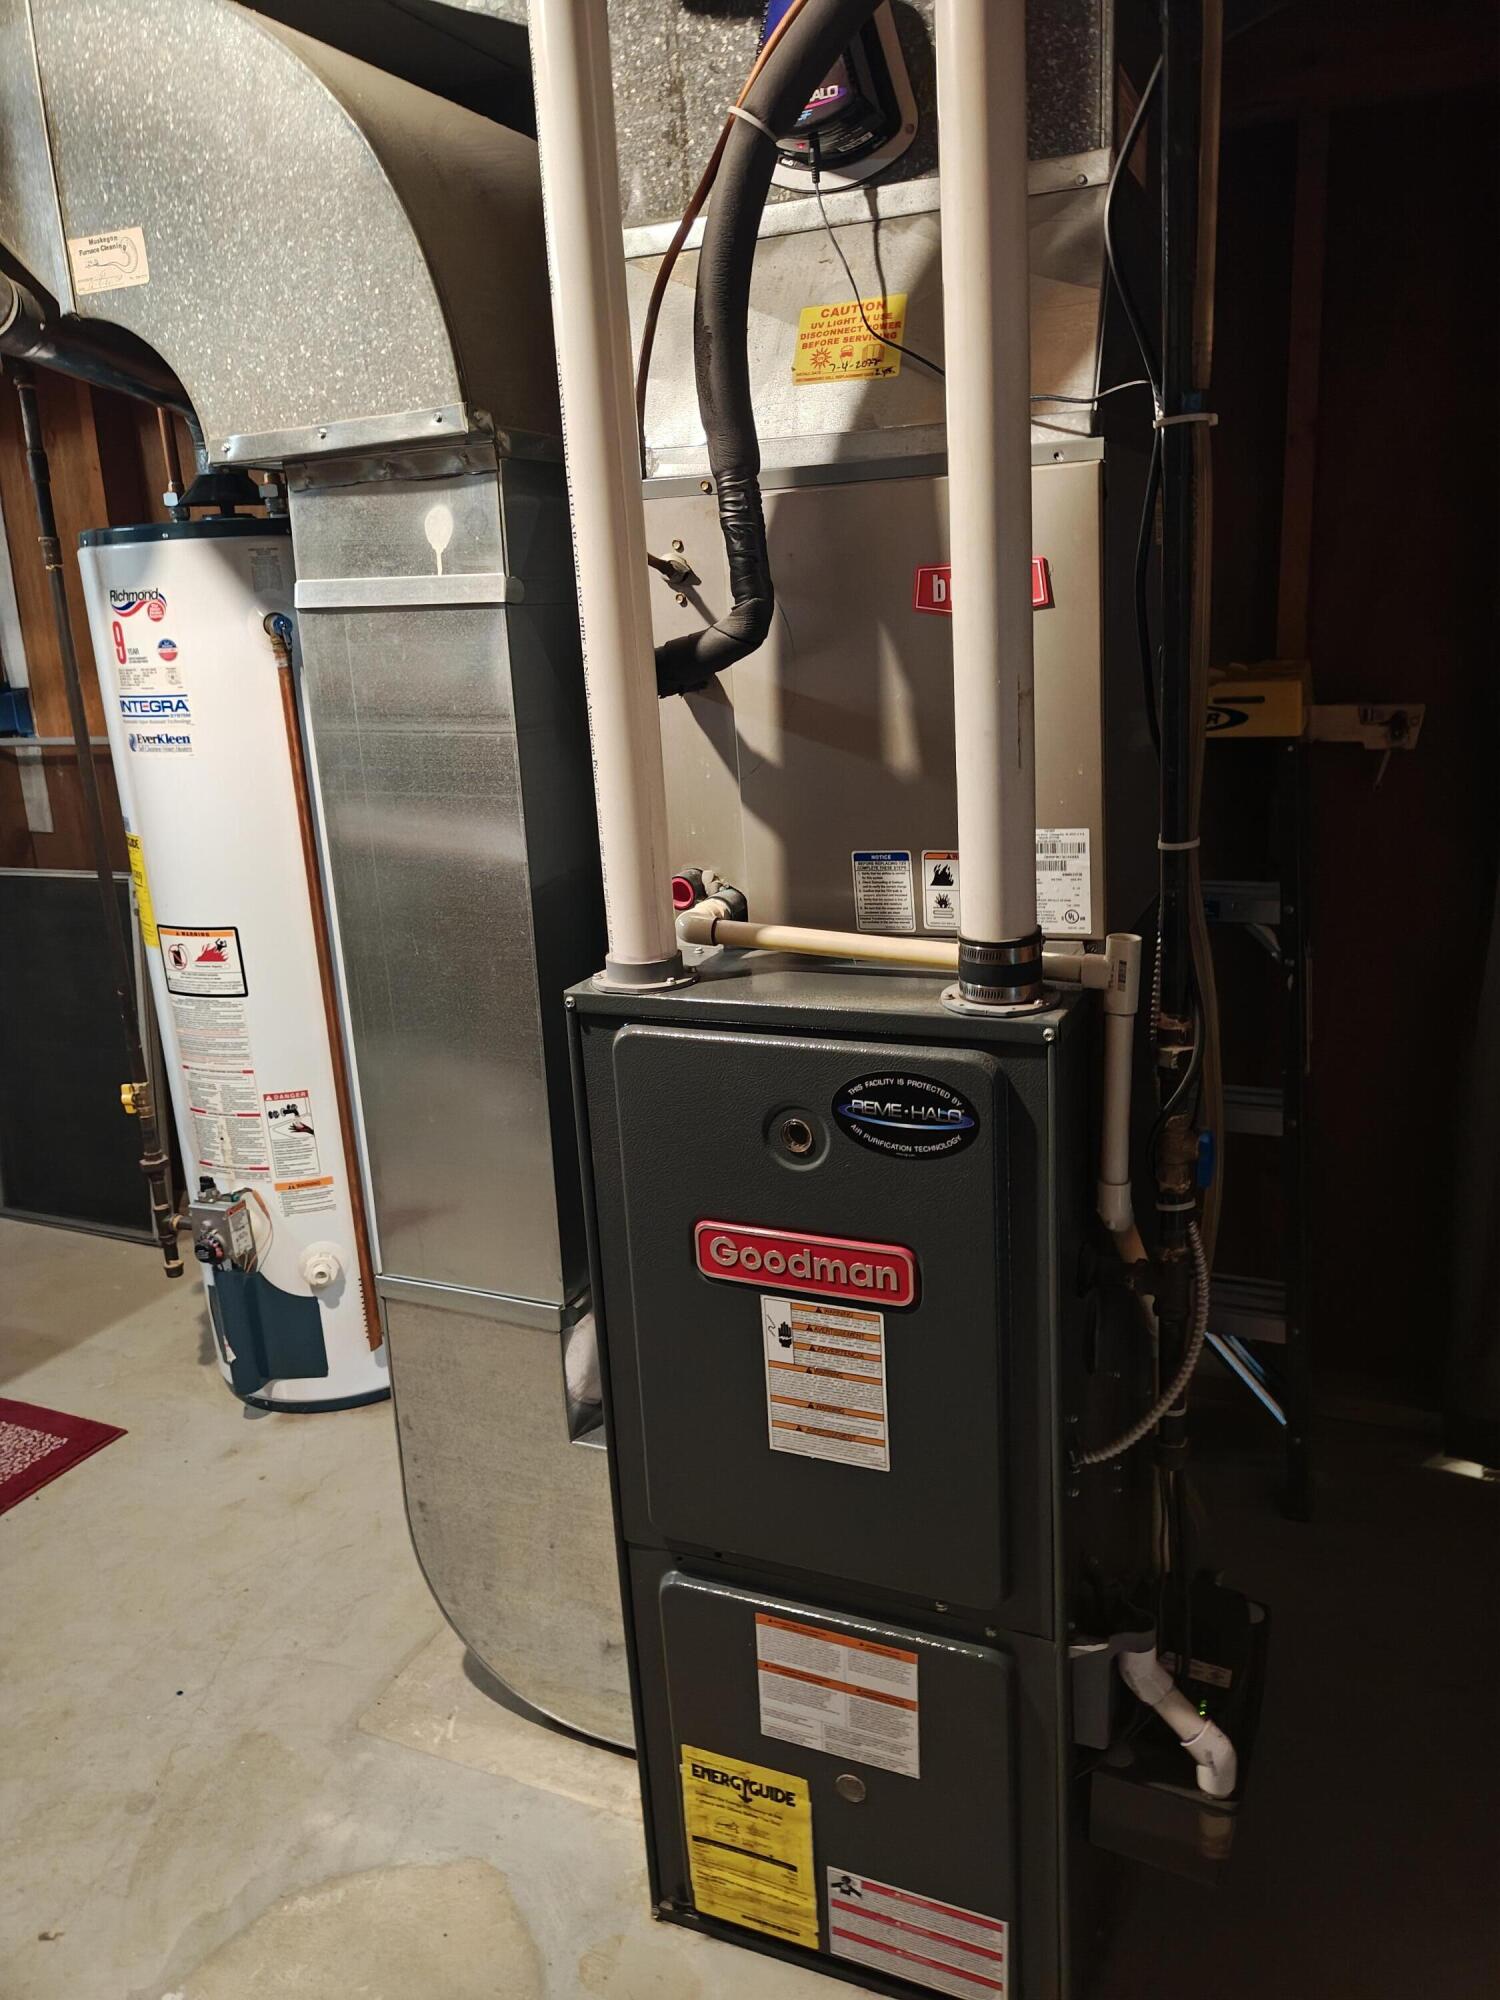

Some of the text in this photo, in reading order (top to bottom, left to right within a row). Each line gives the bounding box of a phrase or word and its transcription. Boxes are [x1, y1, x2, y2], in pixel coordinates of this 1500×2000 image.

[810, 85, 839, 103] ALO
[88, 236, 118, 245] Muskegon
[79, 242, 126, 256] Furnace Cleaning
[811, 322, 824, 330] UV
[827, 317, 857, 329] LIGHT
[873, 312, 893, 320] USE
[800, 320, 901, 340] DISCONNECT OWER
[801, 338, 840, 349] BEFORE
[109, 588, 158, 602] Richmond
[112, 621, 126, 664] 9
[119, 700, 189, 712] INTEGRA
[136, 733, 191, 745] EverKleen
[273, 1091, 306, 1100] DANGER
[847, 1083, 863, 1096] THIS
[864, 1078, 894, 1088] FACILITY
[907, 1079, 950, 1100] PROTECTED
[951, 1096, 963, 1107] BY
[850, 1123, 962, 1153] AIR PURIFICATION TECHNOLOGY
[709, 1236, 898, 1291] Goodman
